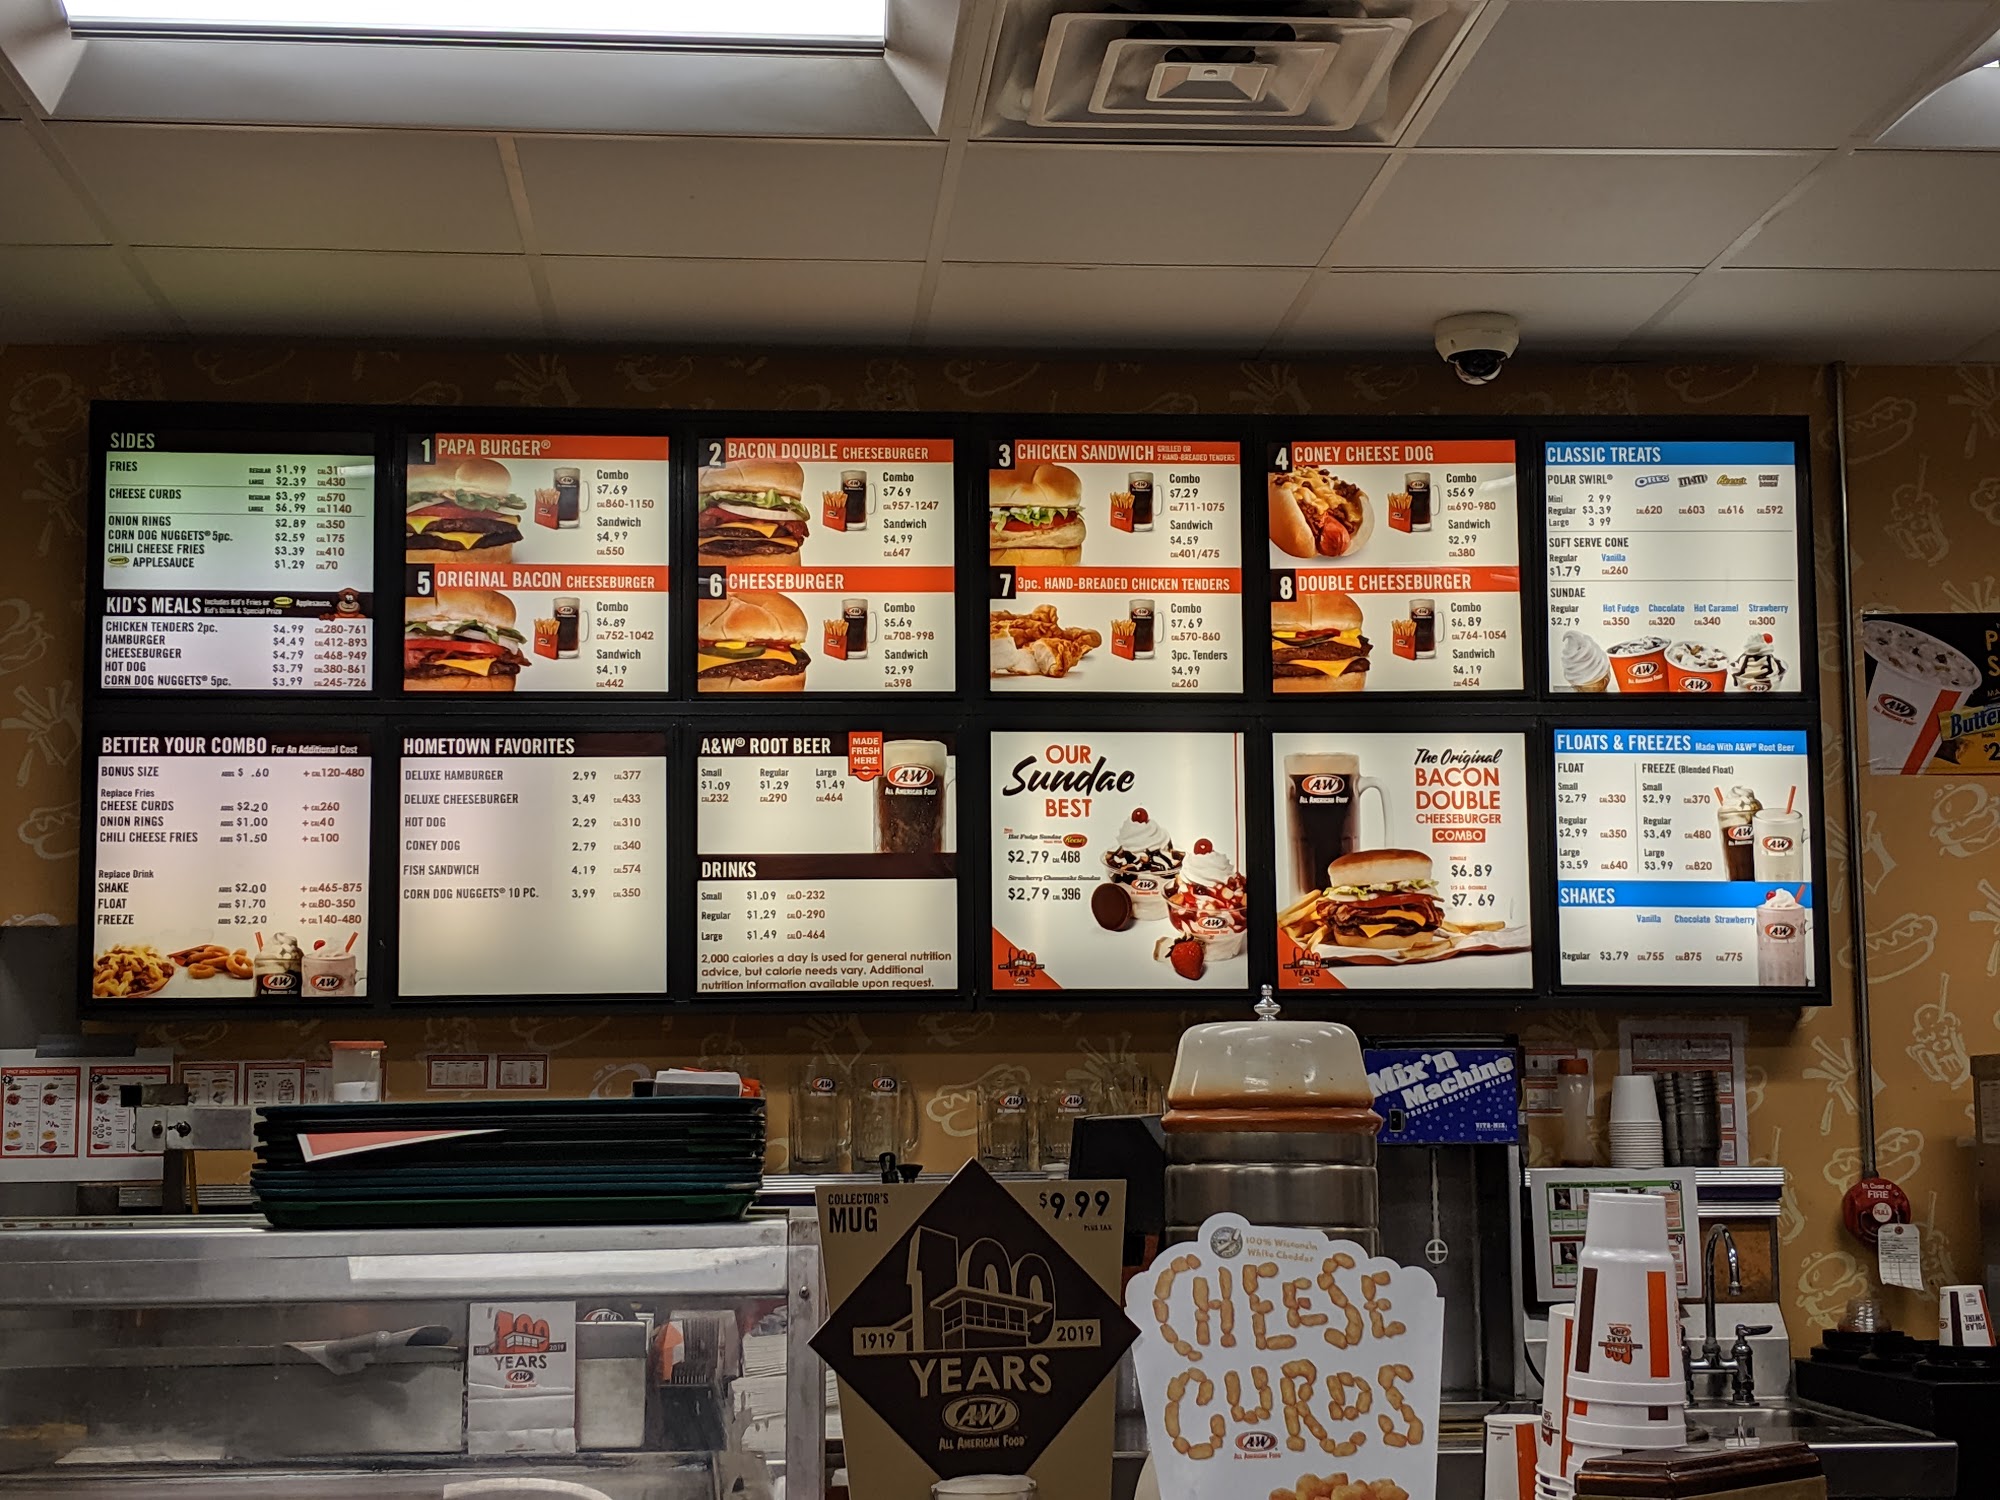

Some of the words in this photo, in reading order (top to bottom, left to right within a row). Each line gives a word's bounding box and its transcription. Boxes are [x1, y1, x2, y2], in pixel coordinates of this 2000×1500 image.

[111, 433, 155, 449] SIDES
[422, 438, 431, 462] 1
[438, 439, 476, 455] PAPA
[709, 443, 721, 467] 2
[728, 443, 776, 459] BACON
[782, 444, 837, 459] DOUBLE
[843, 448, 928, 459] CHEESEBURGER
[999, 444, 1011, 467] 3
[1017, 444, 1076, 460] CHICKEN
[1081, 445, 1154, 460] SANDWICH
[1547, 447, 1605, 463] CLASSIC
[1610, 447, 1661, 463] TREATS
[1275, 447, 1288, 471] 4
[1294, 447, 1340, 462] CONEY
[1346, 446, 1400, 462] CHEESE
[1405, 446, 1434, 461] DOG
[109, 461, 138, 471] FRIES
[597, 470, 629, 480] Combo
[1548, 475, 1576, 484] POLAR
[109, 489, 146, 499] CHEESE
[149, 490, 181, 499] CURDS
[109, 516, 138, 526] ONION
[142, 517, 171, 526] RINGS
[597, 517, 641, 527] Sandwich
[883, 519, 927, 529] Sandwich
[108, 544, 134, 554] CHILI
[137, 544, 173, 554] CHEESE
[177, 544, 205, 554] FRIES
[1549, 538, 1571, 547] SOFT
[1574, 538, 1602, 547] SERVE
[1605, 537, 1629, 547] CONE
[133, 558, 195, 568] APPLESAUCE
[1601, 554, 1626, 562] Vanilla
[417, 571, 430, 594] 5
[437, 572, 507, 587] ORIGINAL
[513, 573, 561, 588] BACON
[566, 576, 655, 589] CHEESEBURGER
[710, 573, 722, 597] 6
[729, 574, 844, 589] CHEESEBURGER
[1000, 574, 1011, 597] 7
[1018, 577, 1041, 591] 3pc.
[1045, 578, 1127, 589] HAND-BREADED
[1132, 579, 1178, 590] CHICKEN
[1182, 579, 1230, 590] TENDERS
[1280, 576, 1292, 599] 8
[1299, 575, 1354, 591] DOUBLE
[1359, 574, 1471, 590] CHEESEBURGER
[1551, 588, 1586, 598] SUNDAE
[106, 597, 147, 613] KID'S
[152, 597, 201, 613] MEALS
[1649, 604, 1685, 612] Chocolate
[1749, 605, 1788, 613] Strawberry
[106, 622, 148, 632] CHICKEN
[151, 622, 194, 632] TENDERS
[198, 623, 217, 634] 2pc.
[105, 635, 165, 645] HAMBURGER
[105, 648, 181, 658] CHEESEBURGER
[105, 662, 124, 671] HOT
[127, 662, 146, 671] DOG
[1950, 708, 2000, 738] Butte
[102, 737, 159, 753] BETTER
[165, 737, 206, 753] YOUR
[211, 737, 266, 753] COMBO
[404, 738, 490, 754] HOMETOWN
[495, 738, 575, 754] FAVORITES
[750, 738, 788, 754] ROOT
[793, 738, 831, 753] BEER
[1557, 735, 1608, 750] FLOATS
[1614, 735, 1623, 750] &
[1629, 735, 1691, 751] FREEZES
[1046, 745, 1091, 764] OUR
[1414, 748, 1437, 765] The
[1441, 748, 1503, 771] Original
[101, 767, 134, 776] BONUS
[137, 767, 159, 776] SIZE
[1558, 763, 1584, 773] FLOAT
[1642, 764, 1675, 773] FREEZE
[405, 771, 441, 780] DELUXE
[444, 771, 503, 780] HAMBURGER
[1003, 756, 1135, 796] Sundae
[1416, 767, 1499, 786] BACON
[101, 801, 138, 811] CHEESE
[142, 801, 174, 811] CURDS
[1416, 791, 1500, 810] DOUBLE
[1045, 799, 1092, 817] BEST
[405, 817, 424, 827] HOT
[426, 817, 446, 827] DOG
[1416, 813, 1501, 823] CHEESEBURGER
[1435, 830, 1483, 841] COMBO
[406, 841, 438, 850] CONEY
[441, 841, 460, 850] DOG
[1008, 850, 1049, 864] $2.79
[404, 865, 425, 875] FISH
[428, 865, 479, 875] SANDWICH
[702, 862, 756, 878] DRINKS
[1451, 864, 1492, 878] $6.89
[98, 883, 128, 892] SHAKE
[1561, 888, 1615, 904] SHAKES
[98, 899, 127, 908] FLOAT
[98, 915, 134, 924] FREEZE
[701, 954, 729, 964] 2,000
[732, 953, 774, 962] calories
[788, 952, 808, 964] day
[811, 953, 818, 962] is
[822, 952, 847, 961] used
[849, 952, 863, 961] for
[867, 952, 907, 963] general
[910, 952, 951, 961] nutrition
[1401, 1057, 1514, 1109] Machine
[828, 1193, 889, 1205] COLLECTOR'S
[1039, 1190, 1110, 1220] $9.99
[829, 1207, 878, 1233] MUG
[1153, 1253, 1406, 1361] CHEESE
[861, 1332, 895, 1349] 1919
[1056, 1326, 1094, 1341] 2019
[495, 1355, 547, 1370] YEARS
[909, 1354, 1052, 1398] YEARS
[1165, 1359, 1423, 1460] CURDS
